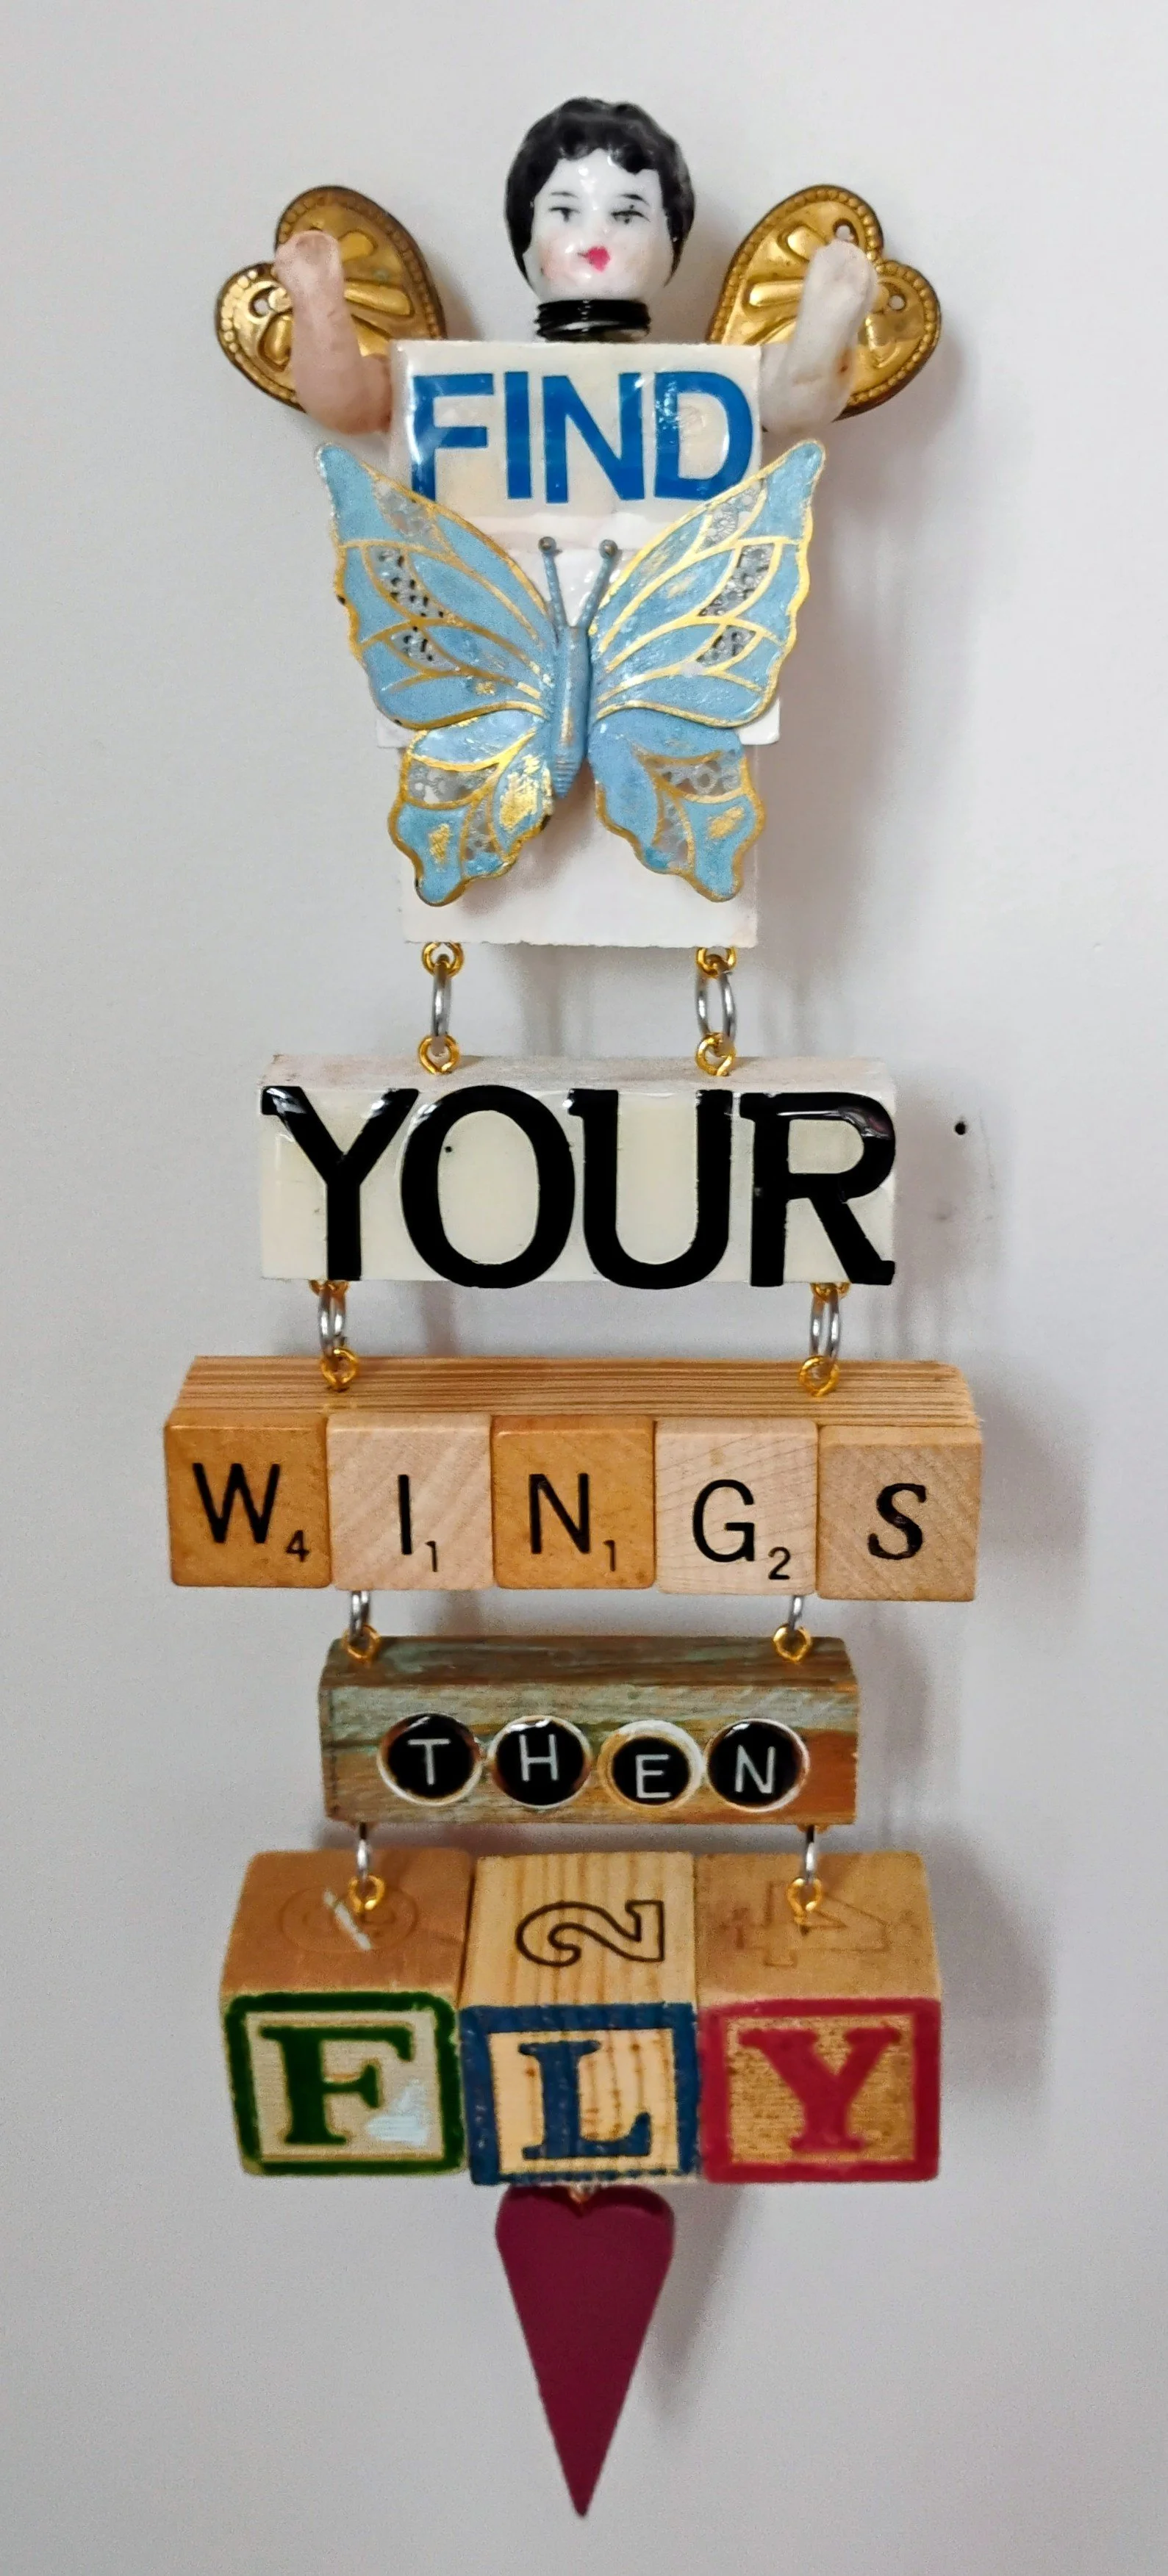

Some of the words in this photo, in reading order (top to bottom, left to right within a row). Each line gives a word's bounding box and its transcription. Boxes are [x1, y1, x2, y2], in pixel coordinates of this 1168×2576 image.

[409, 371, 754, 504] FIND
[261, 1084, 896, 1290] YOUR
[190, 1461, 928, 1562] WINGS
[284, 1529, 310, 1564] 4
[425, 1540, 439, 1573] 1
[603, 1540, 617, 1572] 1
[767, 1547, 792, 1581] 2
[407, 1733, 776, 1799] THEN
[515, 1899, 666, 1968] 2
[259, 2023, 903, 2159] FLY
